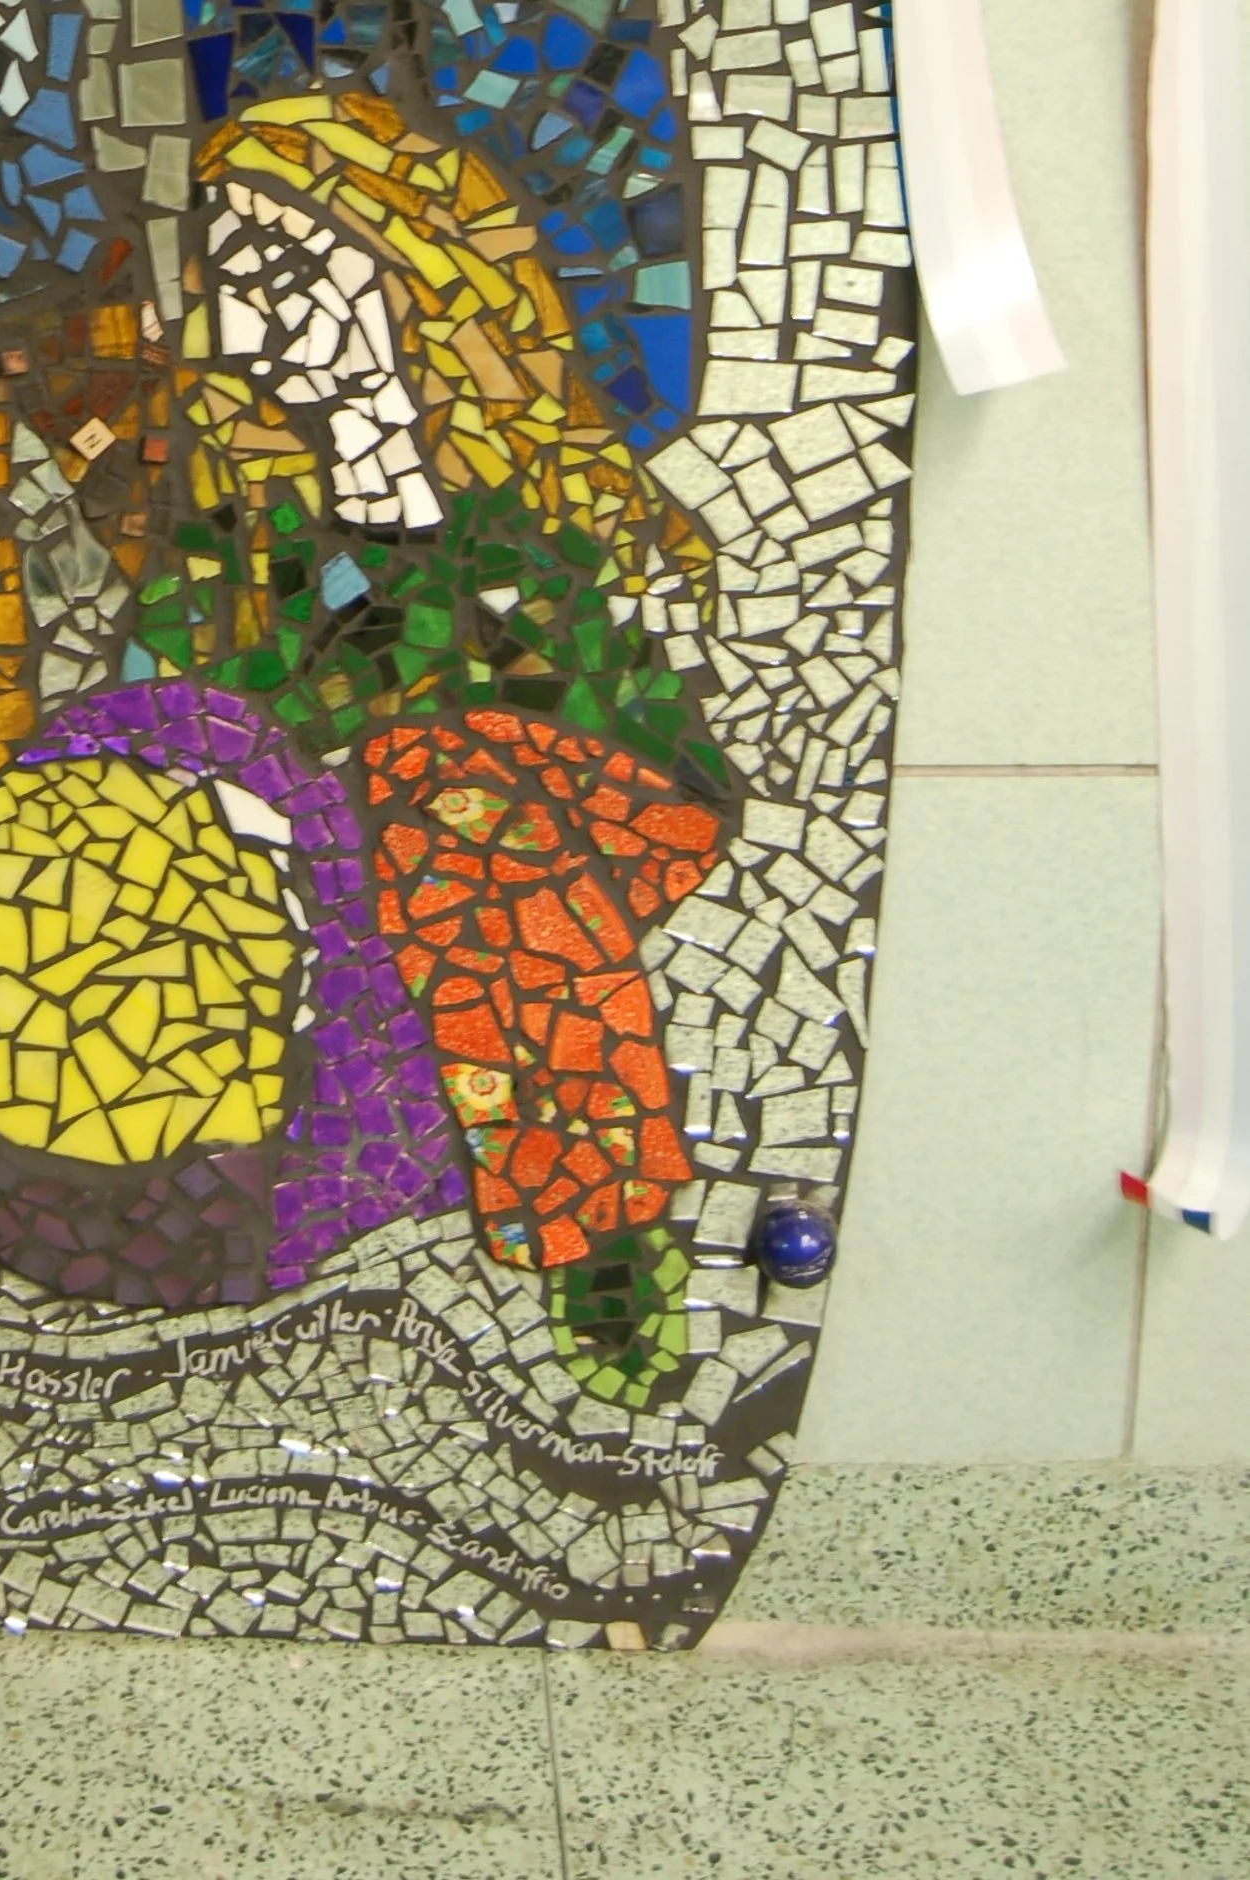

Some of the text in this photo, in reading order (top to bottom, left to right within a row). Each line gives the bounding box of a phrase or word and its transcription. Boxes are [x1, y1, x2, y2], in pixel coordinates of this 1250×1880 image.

[162, 1299, 381, 1378] Jamie Cutler
[209, 1478, 321, 1508] Luciana
[0, 1499, 108, 1535] Caroline
